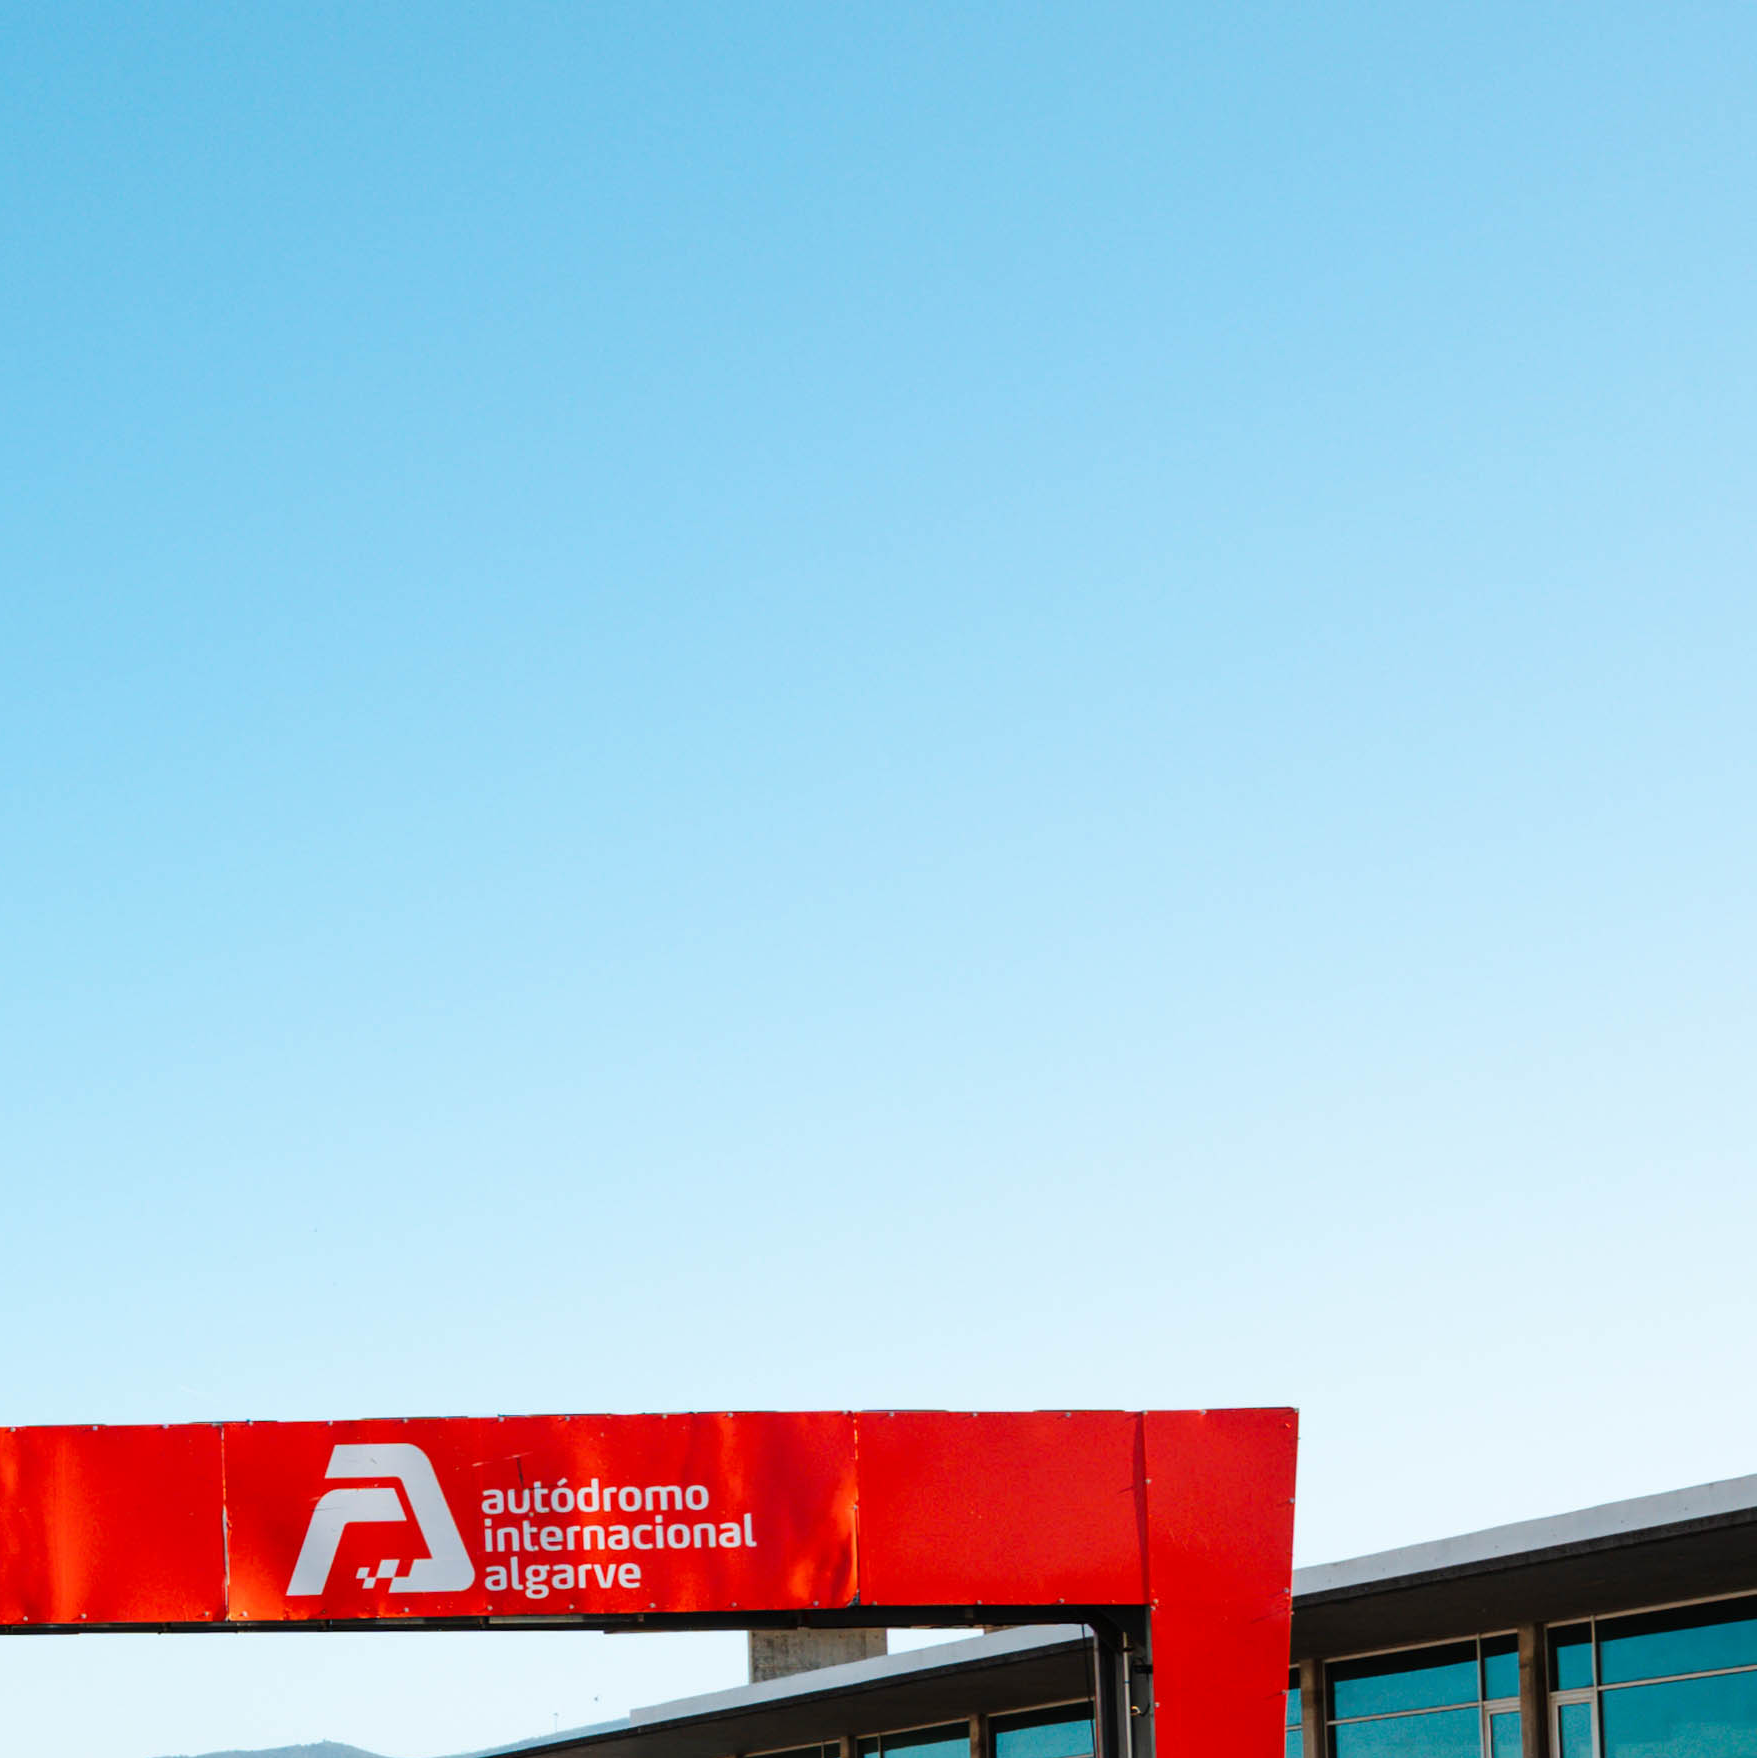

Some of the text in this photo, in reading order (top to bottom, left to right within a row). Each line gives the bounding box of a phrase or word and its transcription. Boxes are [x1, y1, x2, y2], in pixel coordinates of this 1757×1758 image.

[482, 1477, 709, 1515] autódromo
[485, 1512, 757, 1553] internacional
[485, 1556, 642, 1599] algarve
